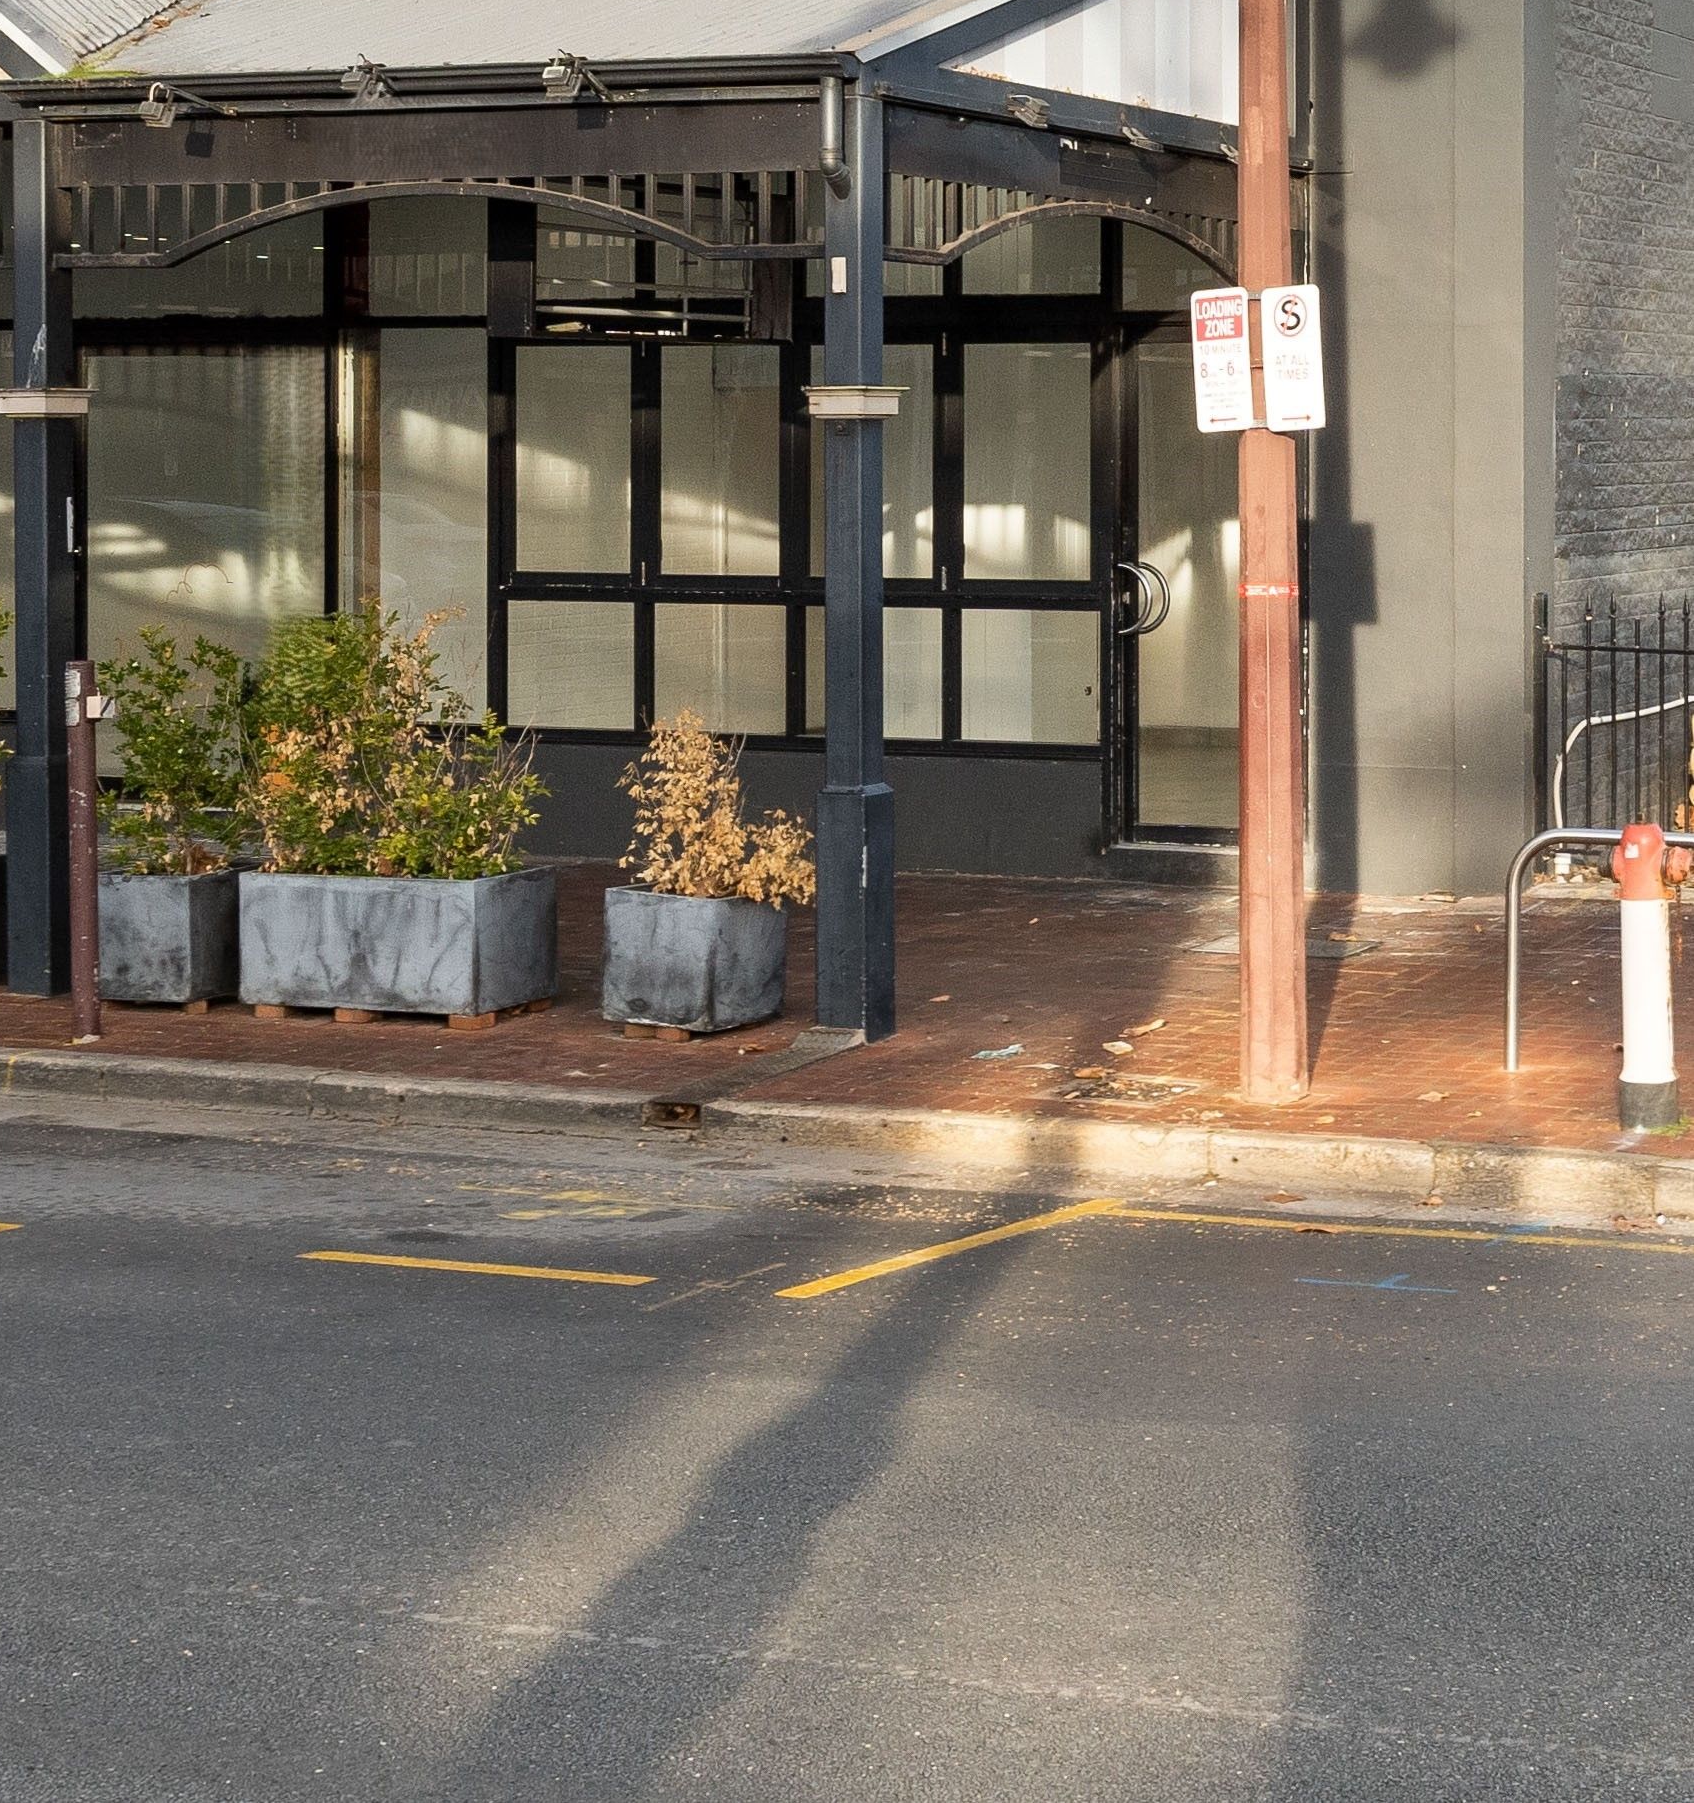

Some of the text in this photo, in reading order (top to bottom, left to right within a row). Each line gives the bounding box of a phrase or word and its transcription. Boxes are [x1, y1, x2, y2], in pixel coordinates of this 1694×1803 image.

[1196, 299, 1243, 319] LOADING
[1204, 318, 1235, 338] ZONE
[1199, 343, 1243, 356] 10 MINUTE
[1275, 353, 1310, 367] AT ALL
[1275, 368, 1310, 381] TIMES
